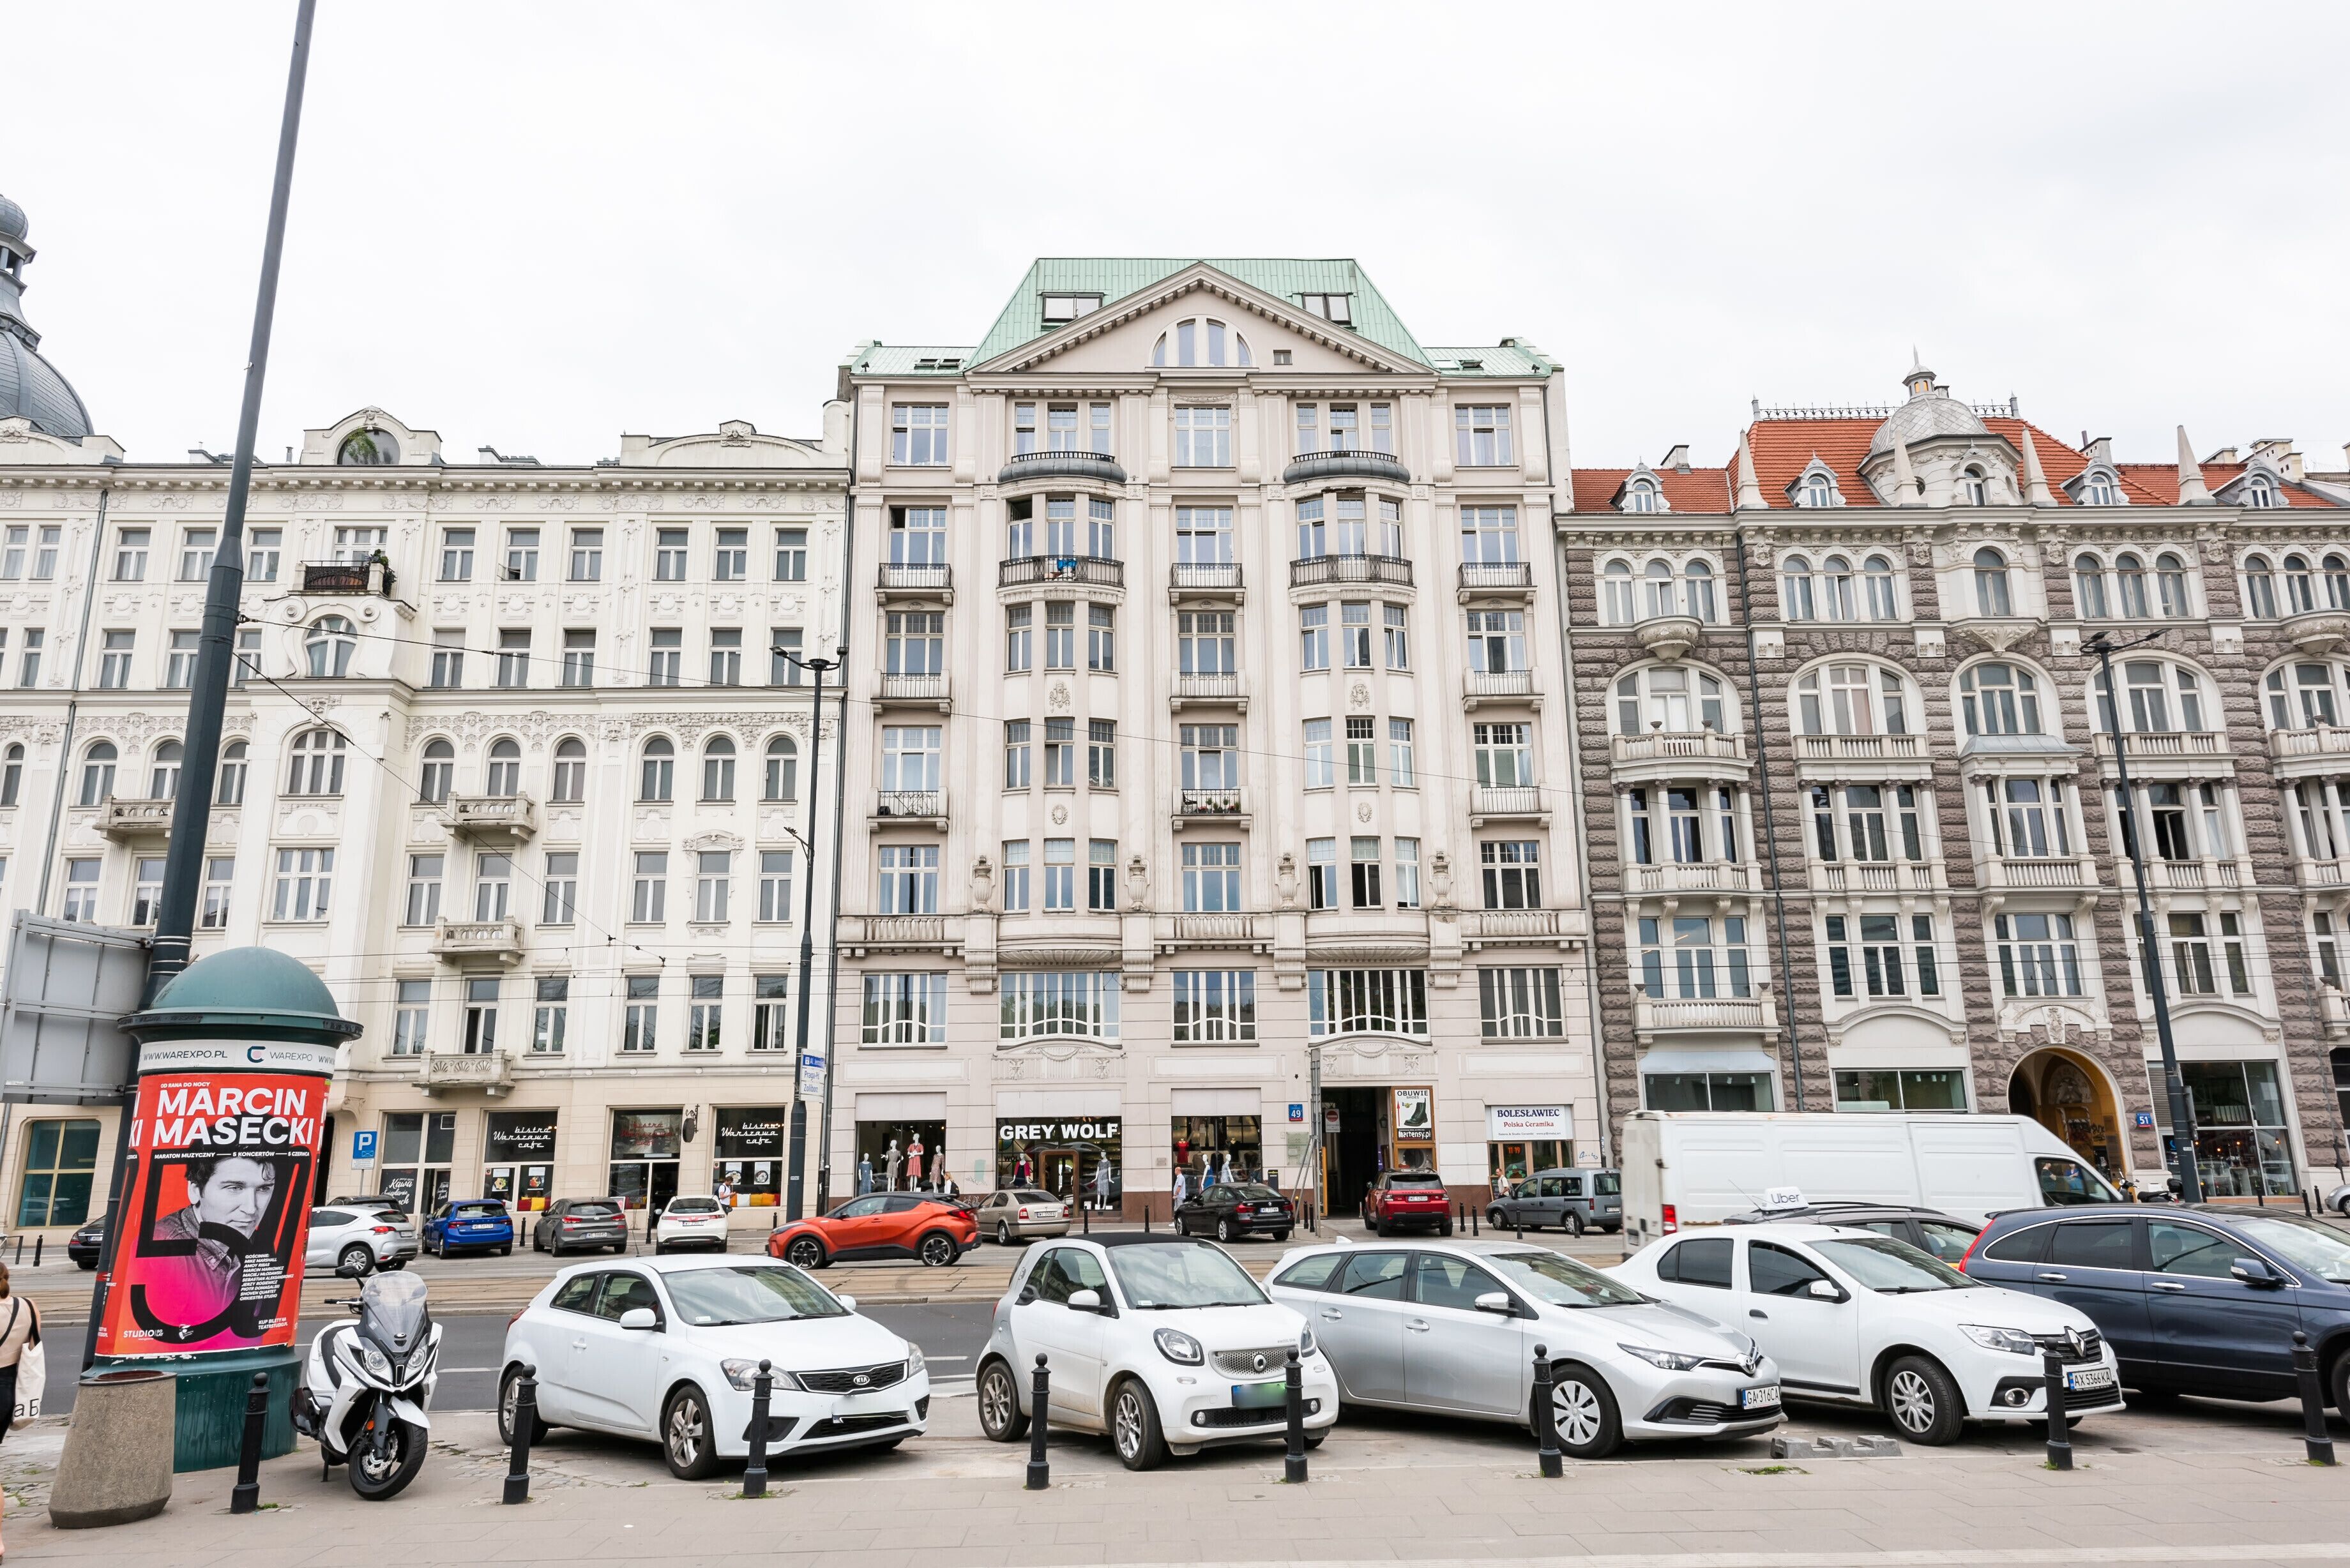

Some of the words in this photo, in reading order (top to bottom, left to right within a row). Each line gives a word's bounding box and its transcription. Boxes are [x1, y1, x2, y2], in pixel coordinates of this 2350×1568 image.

[144, 1050, 228, 1060] WWW.WAREXPO.PL
[269, 1052, 313, 1061] WAREXPO
[156, 1087, 307, 1117] MARCIN
[1291, 1110, 1301, 1118] 49
[1497, 1108, 1560, 1117] BOLESŁAWIEC
[2139, 1116, 2149, 1124] 51
[152, 1116, 315, 1147] MASECKI
[493, 1131, 551, 1141] Warszawa
[721, 1127, 778, 1136] Warszawa
[999, 1124, 1056, 1140] GREY
[1061, 1123, 1118, 1139] WOLF
[1398, 1130, 1431, 1140] Martensy.pl
[358, 1133, 373, 1150] P
[518, 1140, 545, 1149] cafe
[746, 1136, 772, 1145] cafe
[388, 1179, 413, 1189] Kawa
[1770, 1193, 1800, 1204] Uber
[123, 1329, 155, 1338] STUDIO
[2075, 1375, 2085, 1386] AX
[2086, 1372, 2102, 1385] 5366
[2101, 1371, 2111, 1383] KA
[1747, 1391, 1757, 1405] GA
[1759, 1387, 1779, 1403] 316CA
